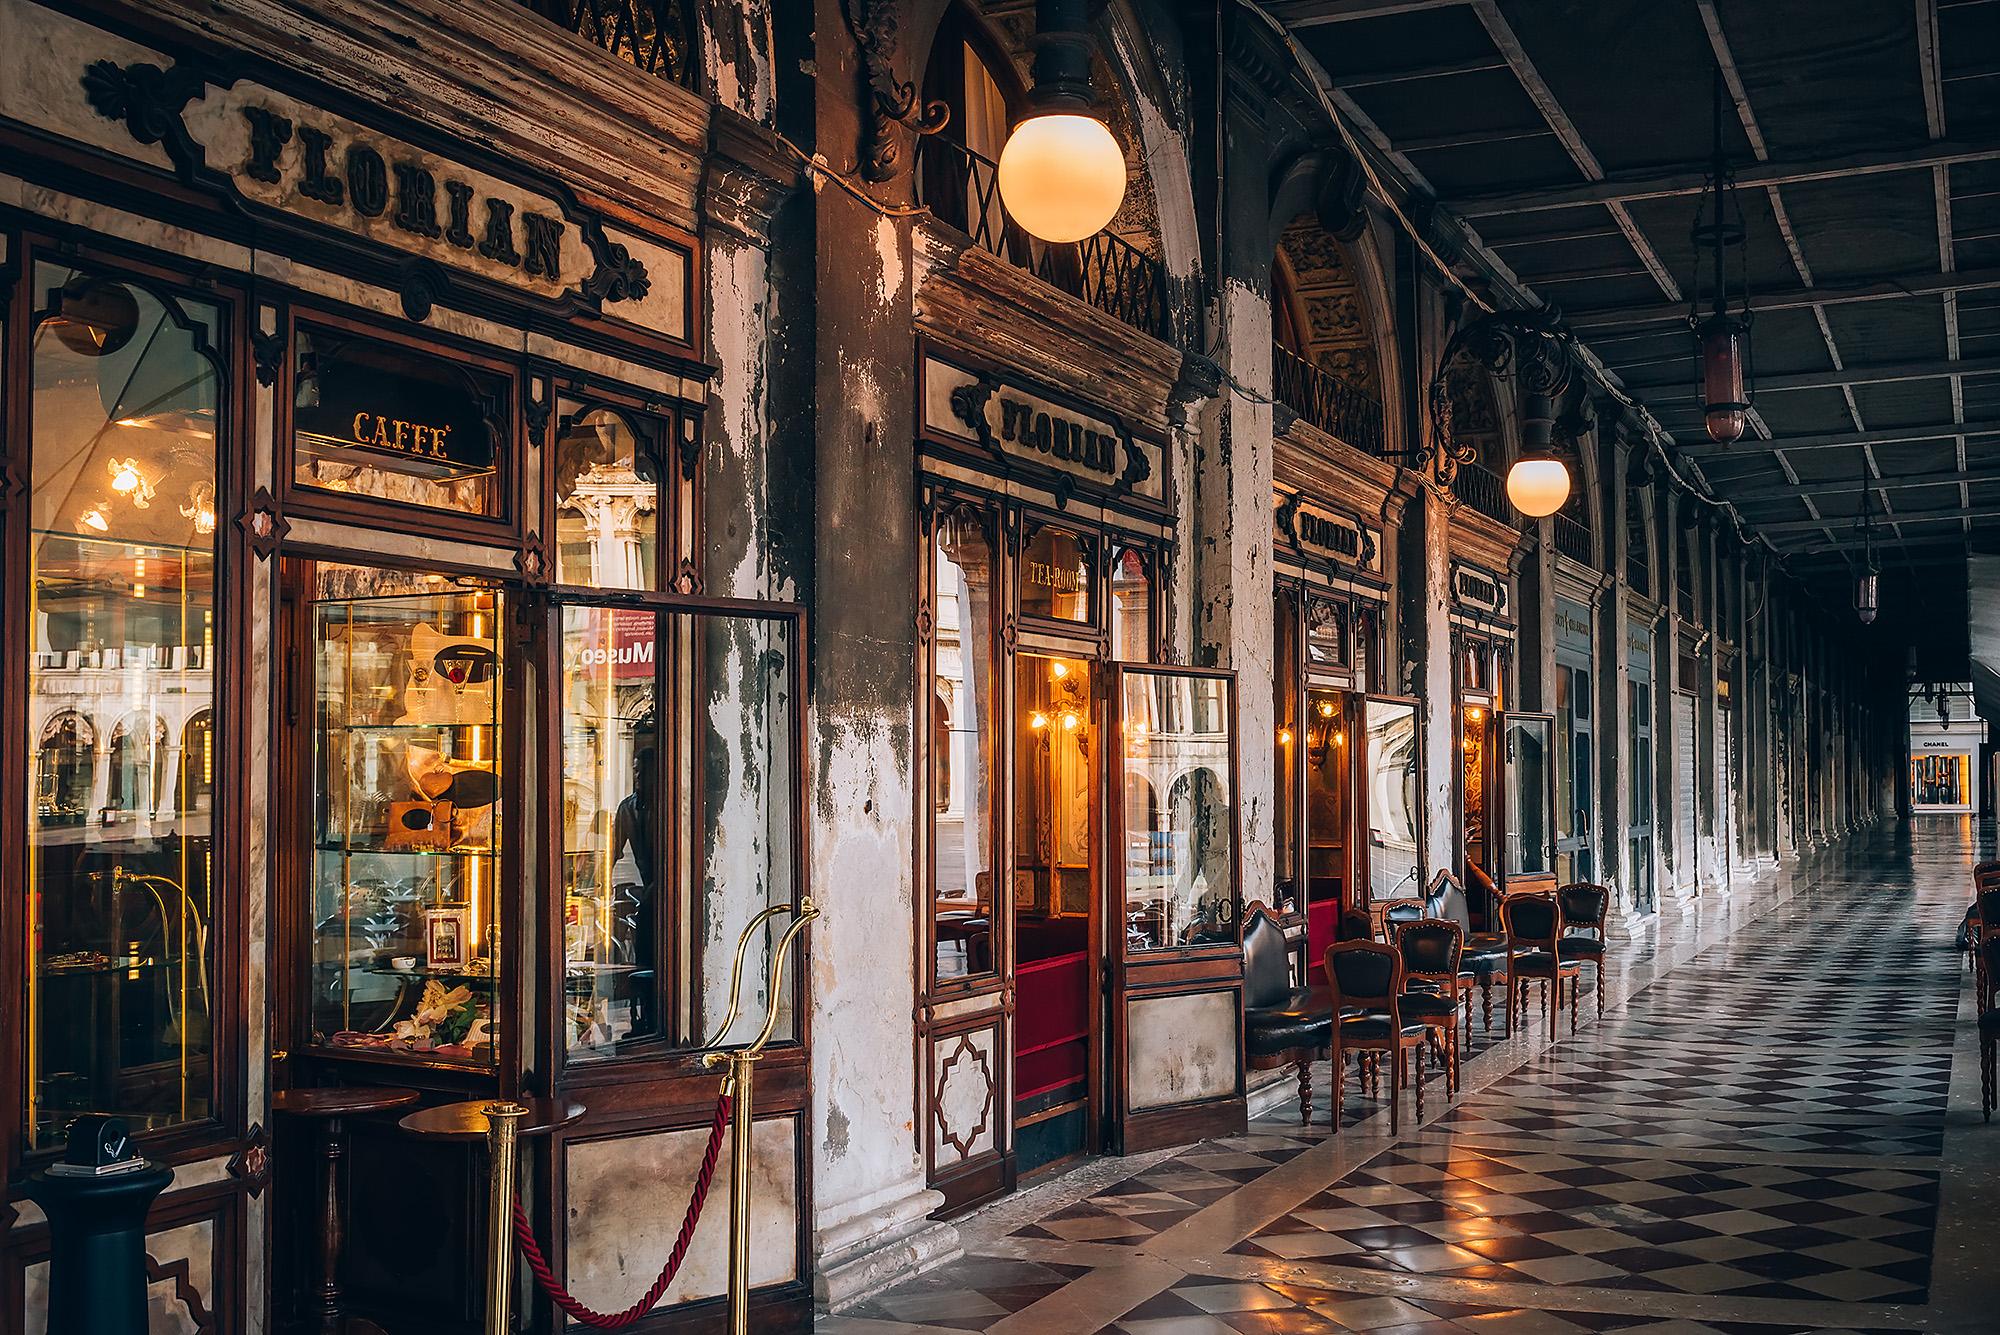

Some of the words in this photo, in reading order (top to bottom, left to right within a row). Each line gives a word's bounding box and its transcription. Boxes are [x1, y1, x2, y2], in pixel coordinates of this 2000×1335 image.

[240, 105, 566, 282] FLORIAN
[1000, 398, 1118, 476] FLORIAN
[1029, 561, 1081, 592] TEA-ROOM
